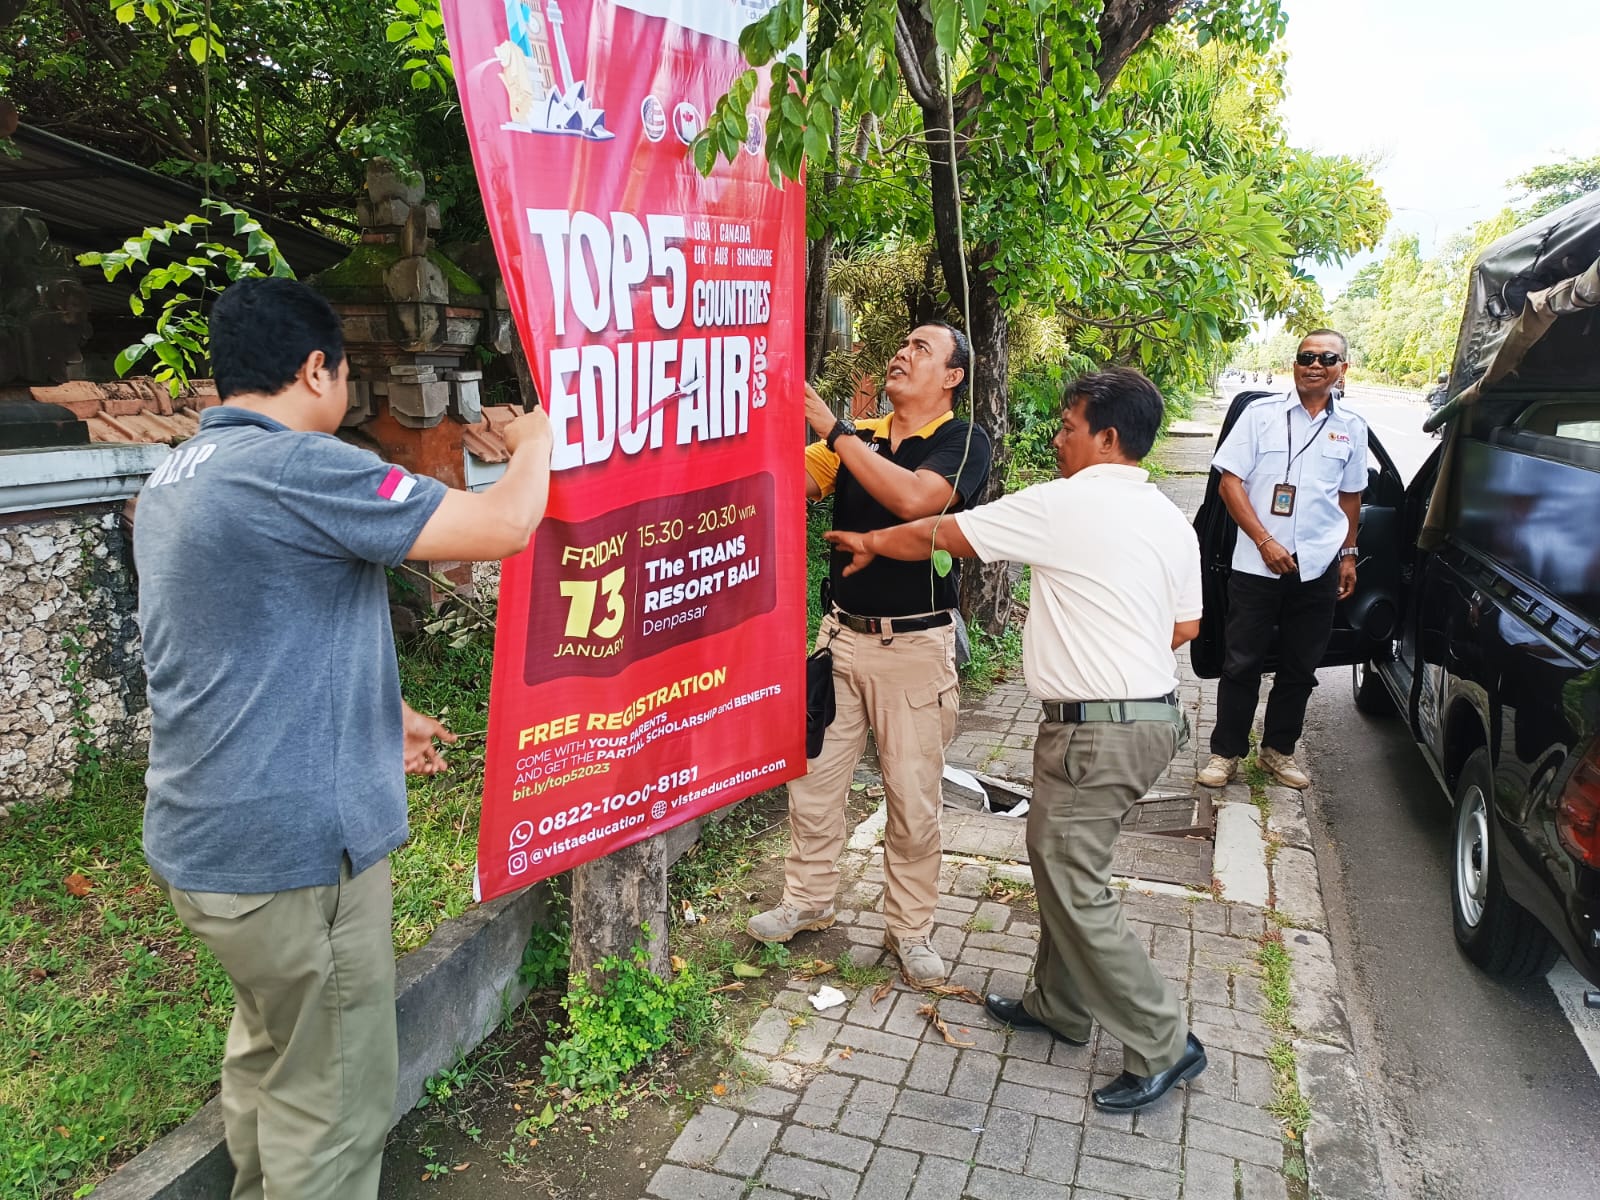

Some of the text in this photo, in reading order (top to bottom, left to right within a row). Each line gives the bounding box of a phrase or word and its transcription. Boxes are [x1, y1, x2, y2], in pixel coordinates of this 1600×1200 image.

[694, 221, 751, 244] USA CANADA
[694, 245, 773, 267] UK AUS SINGAPORE
[693, 279, 771, 327] COUNTRIES
[752, 335, 767, 409] 2023
[550, 336, 751, 471] EDUFAIR
[561, 532, 628, 569] FRIDAY
[637, 519, 684, 548] 15.30
[697, 504, 737, 534] 20.30
[738, 504, 757, 521] WITA
[644, 556, 760, 614] RESORT BALI
[645, 535, 746, 583] The TRANS
[559, 566, 626, 639] 13
[642, 604, 708, 636] Denpasar
[553, 635, 625, 658] JANUARY
[518, 666, 727, 750] FREE REGISTRATION
[514, 684, 781, 786] AND GET THE PARTIAL SCHOLARSHIP and BENEFITS
[516, 712, 668, 771] COME WITH YOUR PARENTS
[512, 762, 611, 802] bit.ly/top52023
[538, 765, 699, 836] 0822-1000-8181
[529, 758, 787, 865] @vistaeducation vistaeducation.com
